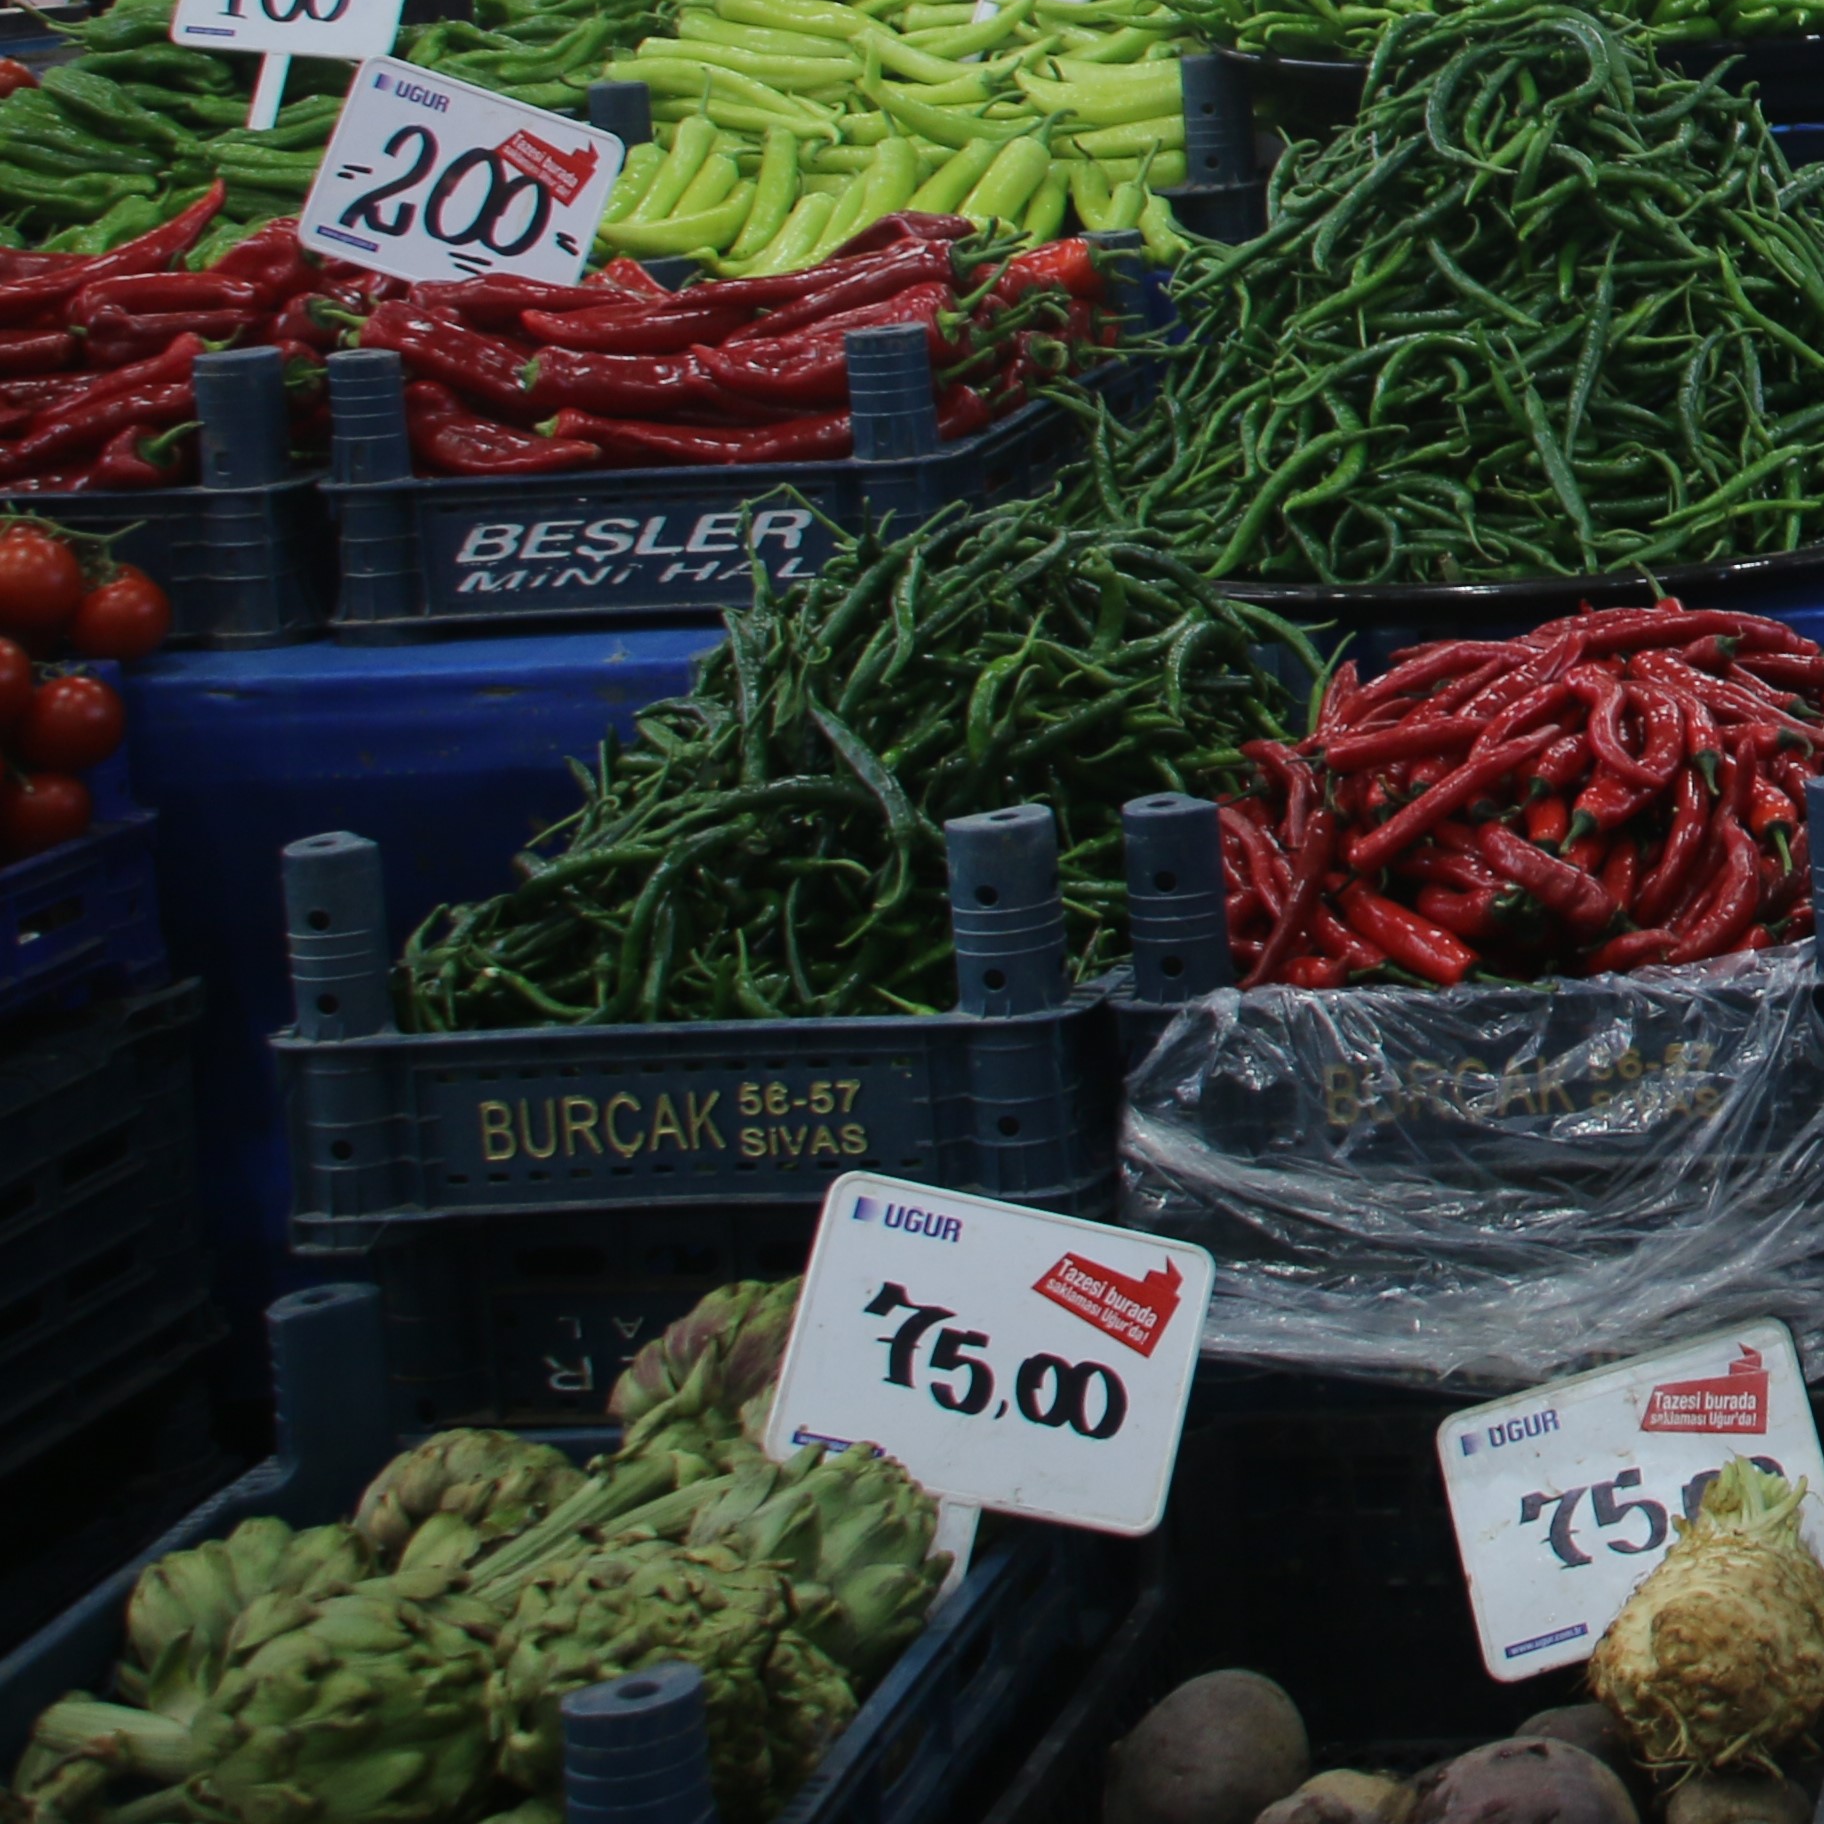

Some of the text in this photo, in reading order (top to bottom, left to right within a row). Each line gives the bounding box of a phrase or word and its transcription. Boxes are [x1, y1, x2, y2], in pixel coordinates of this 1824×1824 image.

[455, 508, 813, 564] BEŞLER
[479, 1090, 727, 1161] BURÇAK
[1056, 1257, 1159, 1330] Tazesi burada
[863, 1281, 1129, 1440] 75,00
[1653, 1390, 1757, 1411] Tazesi burada
